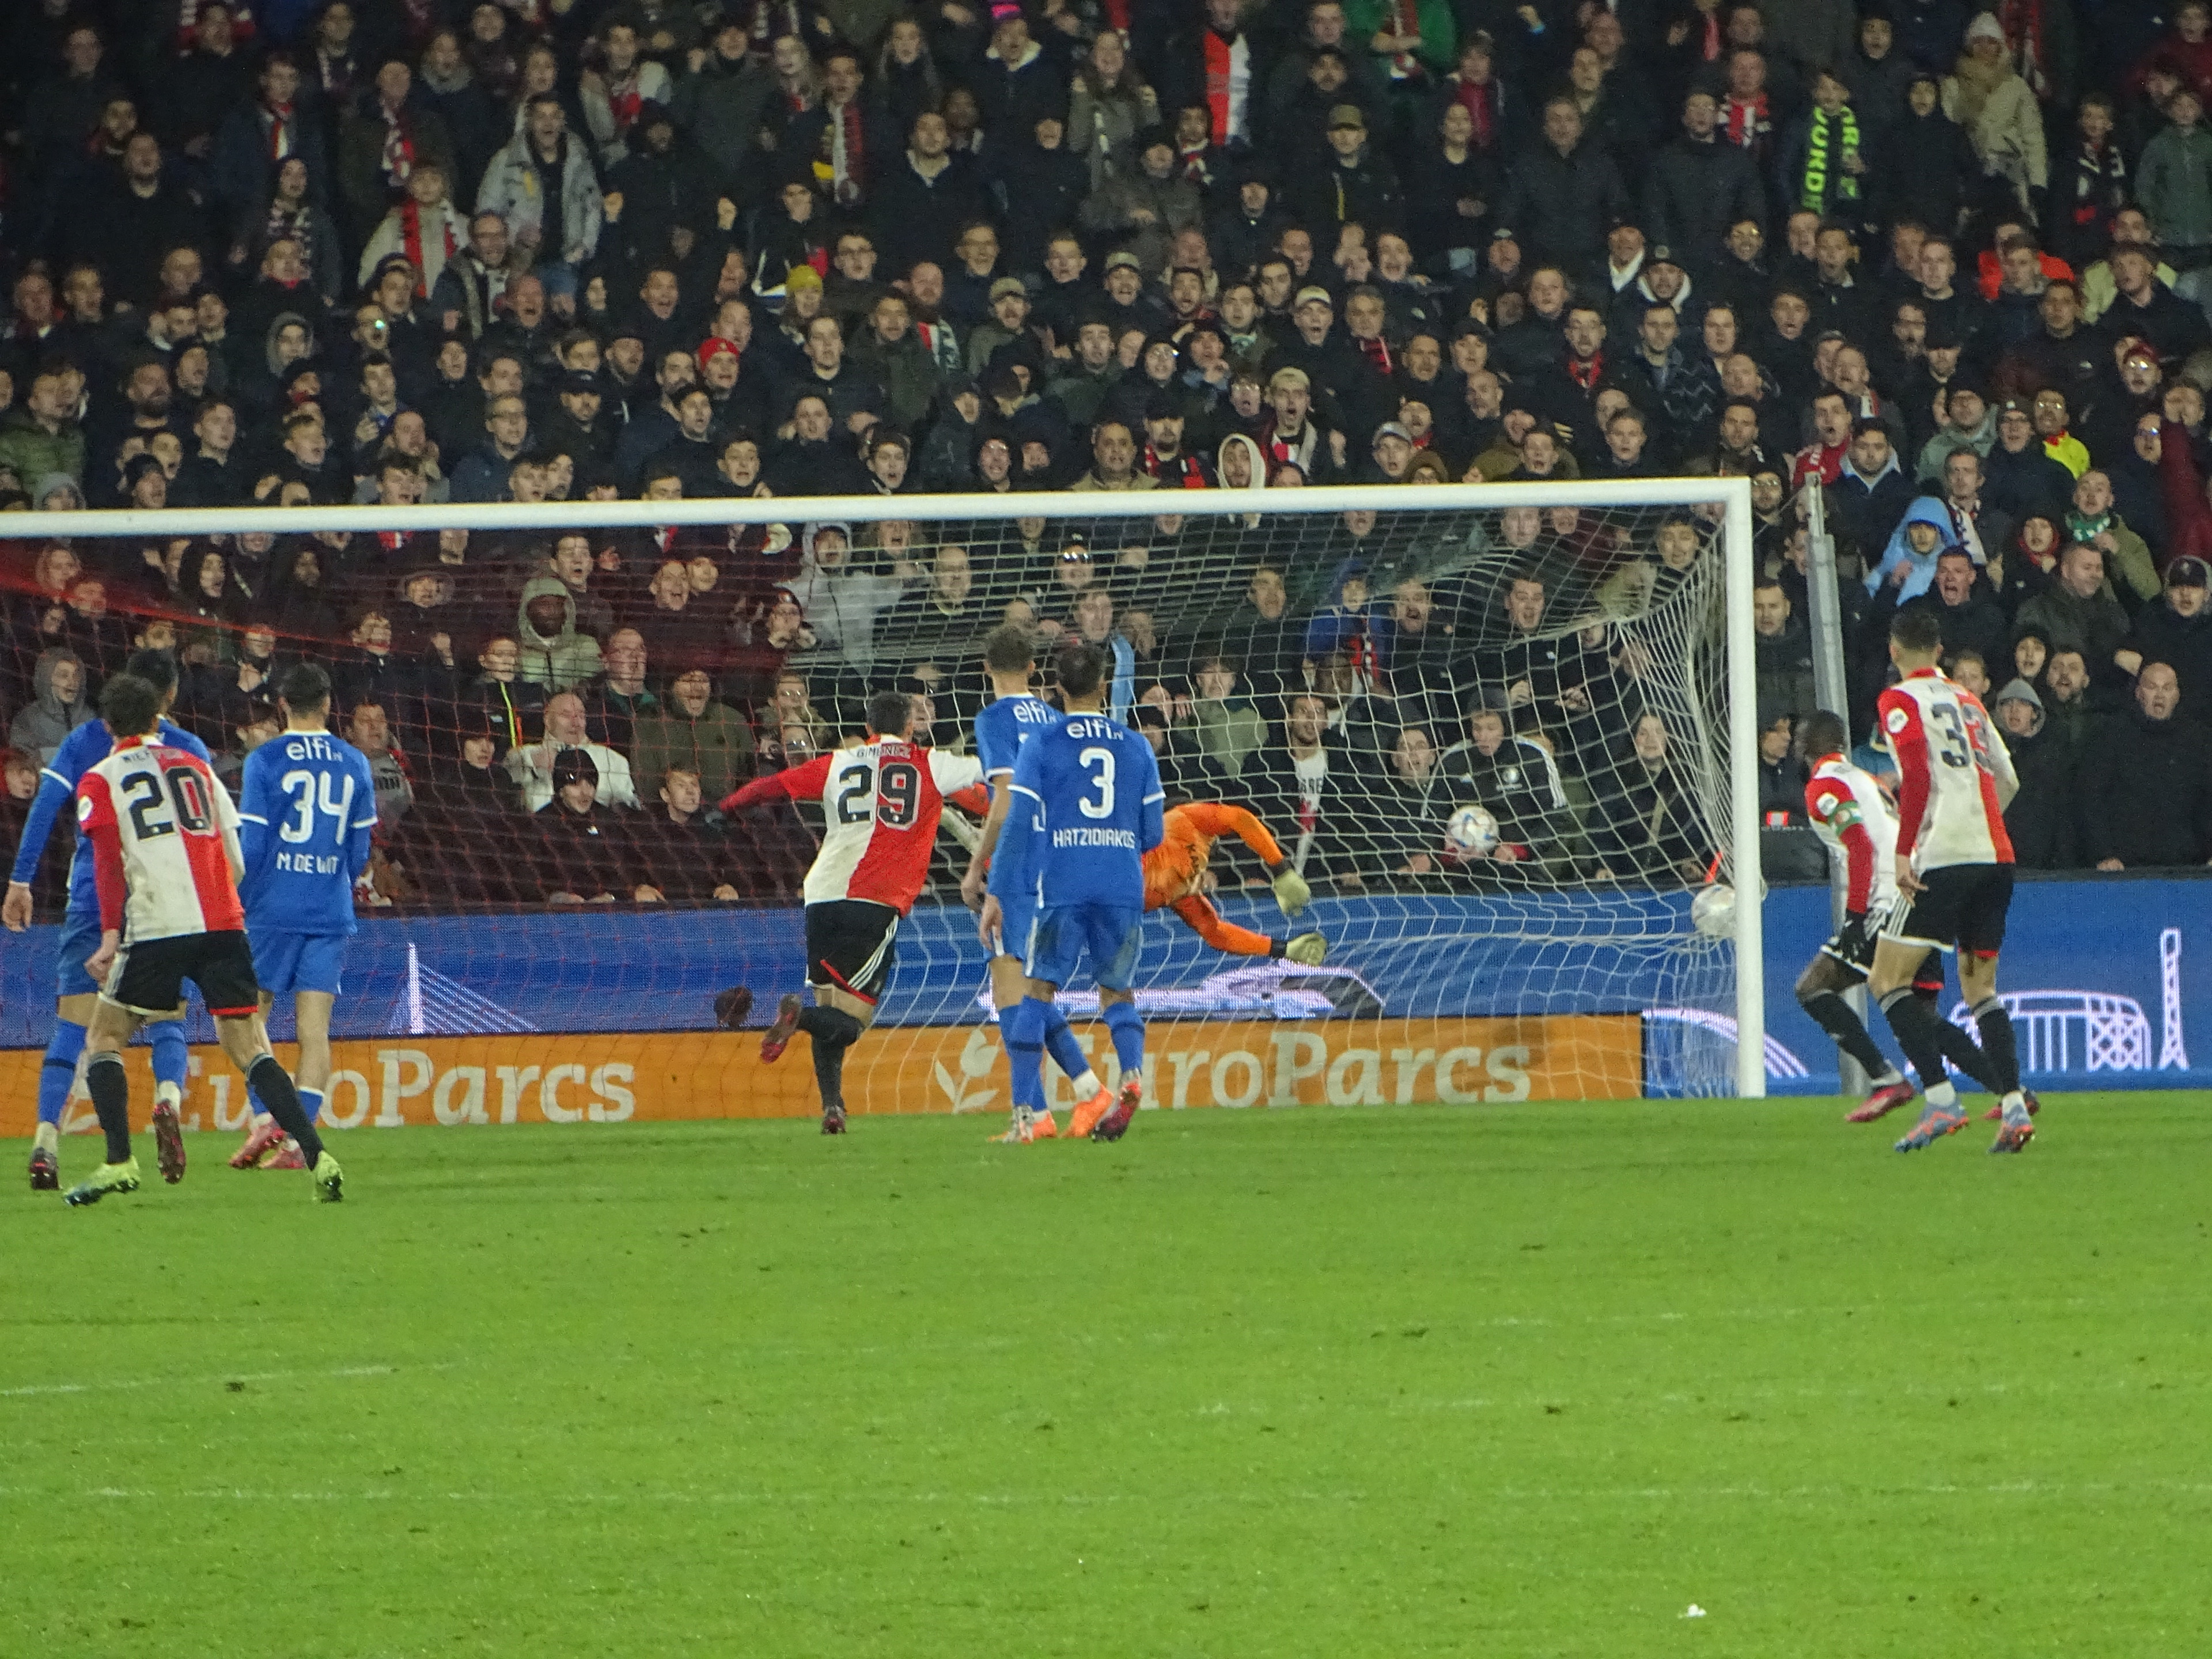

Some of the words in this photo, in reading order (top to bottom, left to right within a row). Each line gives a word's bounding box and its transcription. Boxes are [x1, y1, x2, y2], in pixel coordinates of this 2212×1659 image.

[120, 766, 215, 841] 20
[279, 770, 354, 845] 34
[837, 763, 922, 830] 29
[1078, 747, 1115, 819] 3
[1052, 827, 1135, 849] HATZIDIAKOS
[144, 1049, 635, 1132] uoParcs
